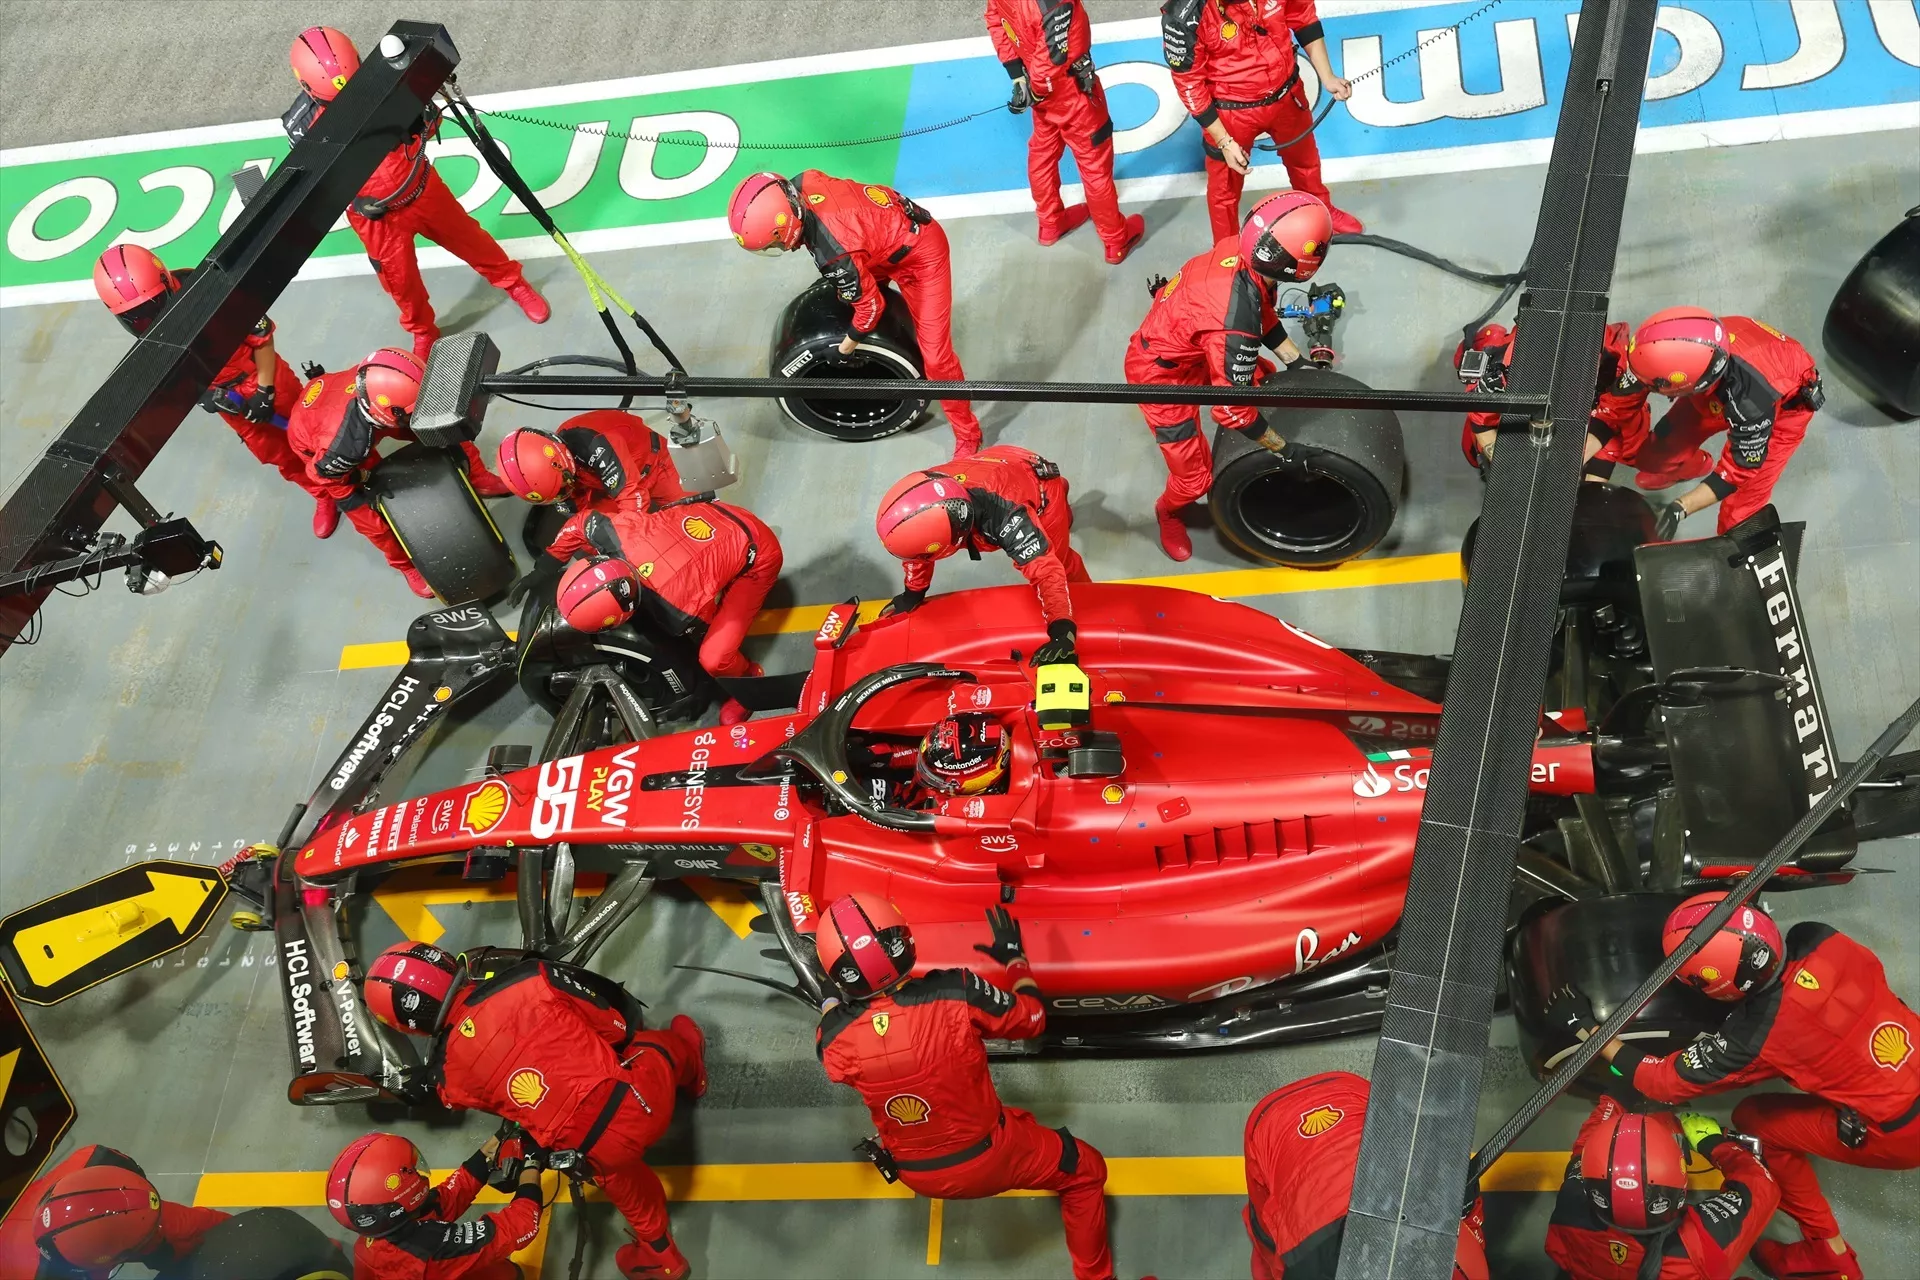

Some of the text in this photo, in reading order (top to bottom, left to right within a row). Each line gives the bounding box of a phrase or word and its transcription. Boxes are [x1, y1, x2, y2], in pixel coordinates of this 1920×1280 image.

[781, 350, 813, 378] PIRELLI
[1019, 540, 1041, 560] VGW
[430, 607, 483, 625] aws
[816, 610, 840, 642] VGW
[829, 620, 844, 639] PLAY
[661, 668, 686, 694] PIRELLI
[856, 673, 903, 704] RICHARD MILLE
[330, 675, 420, 791] HCLSoftware
[943, 754, 982, 771] Santander
[531, 754, 585, 839] 55
[586, 766, 609, 812] PLAY
[601, 745, 640, 827] VGW
[681, 749, 710, 830] GENESYS
[778, 776, 791, 807] Estrella
[366, 806, 389, 858] MAHLE
[387, 801, 409, 852] PIRELLI
[408, 806, 425, 847] Palantir
[438, 799, 455, 832] aws
[334, 818, 353, 867] antander
[607, 843, 730, 852] RICHARD MILLE
[981, 834, 1016, 845] aws
[788, 891, 807, 927] VGW
[801, 894, 814, 913] PLAY
[573, 900, 618, 942] #WeRaceAsOne
[285, 939, 317, 1074] HCLSoftwar
[336, 981, 361, 1057] V-Power
[1687, 1043, 1703, 1070] VGW
